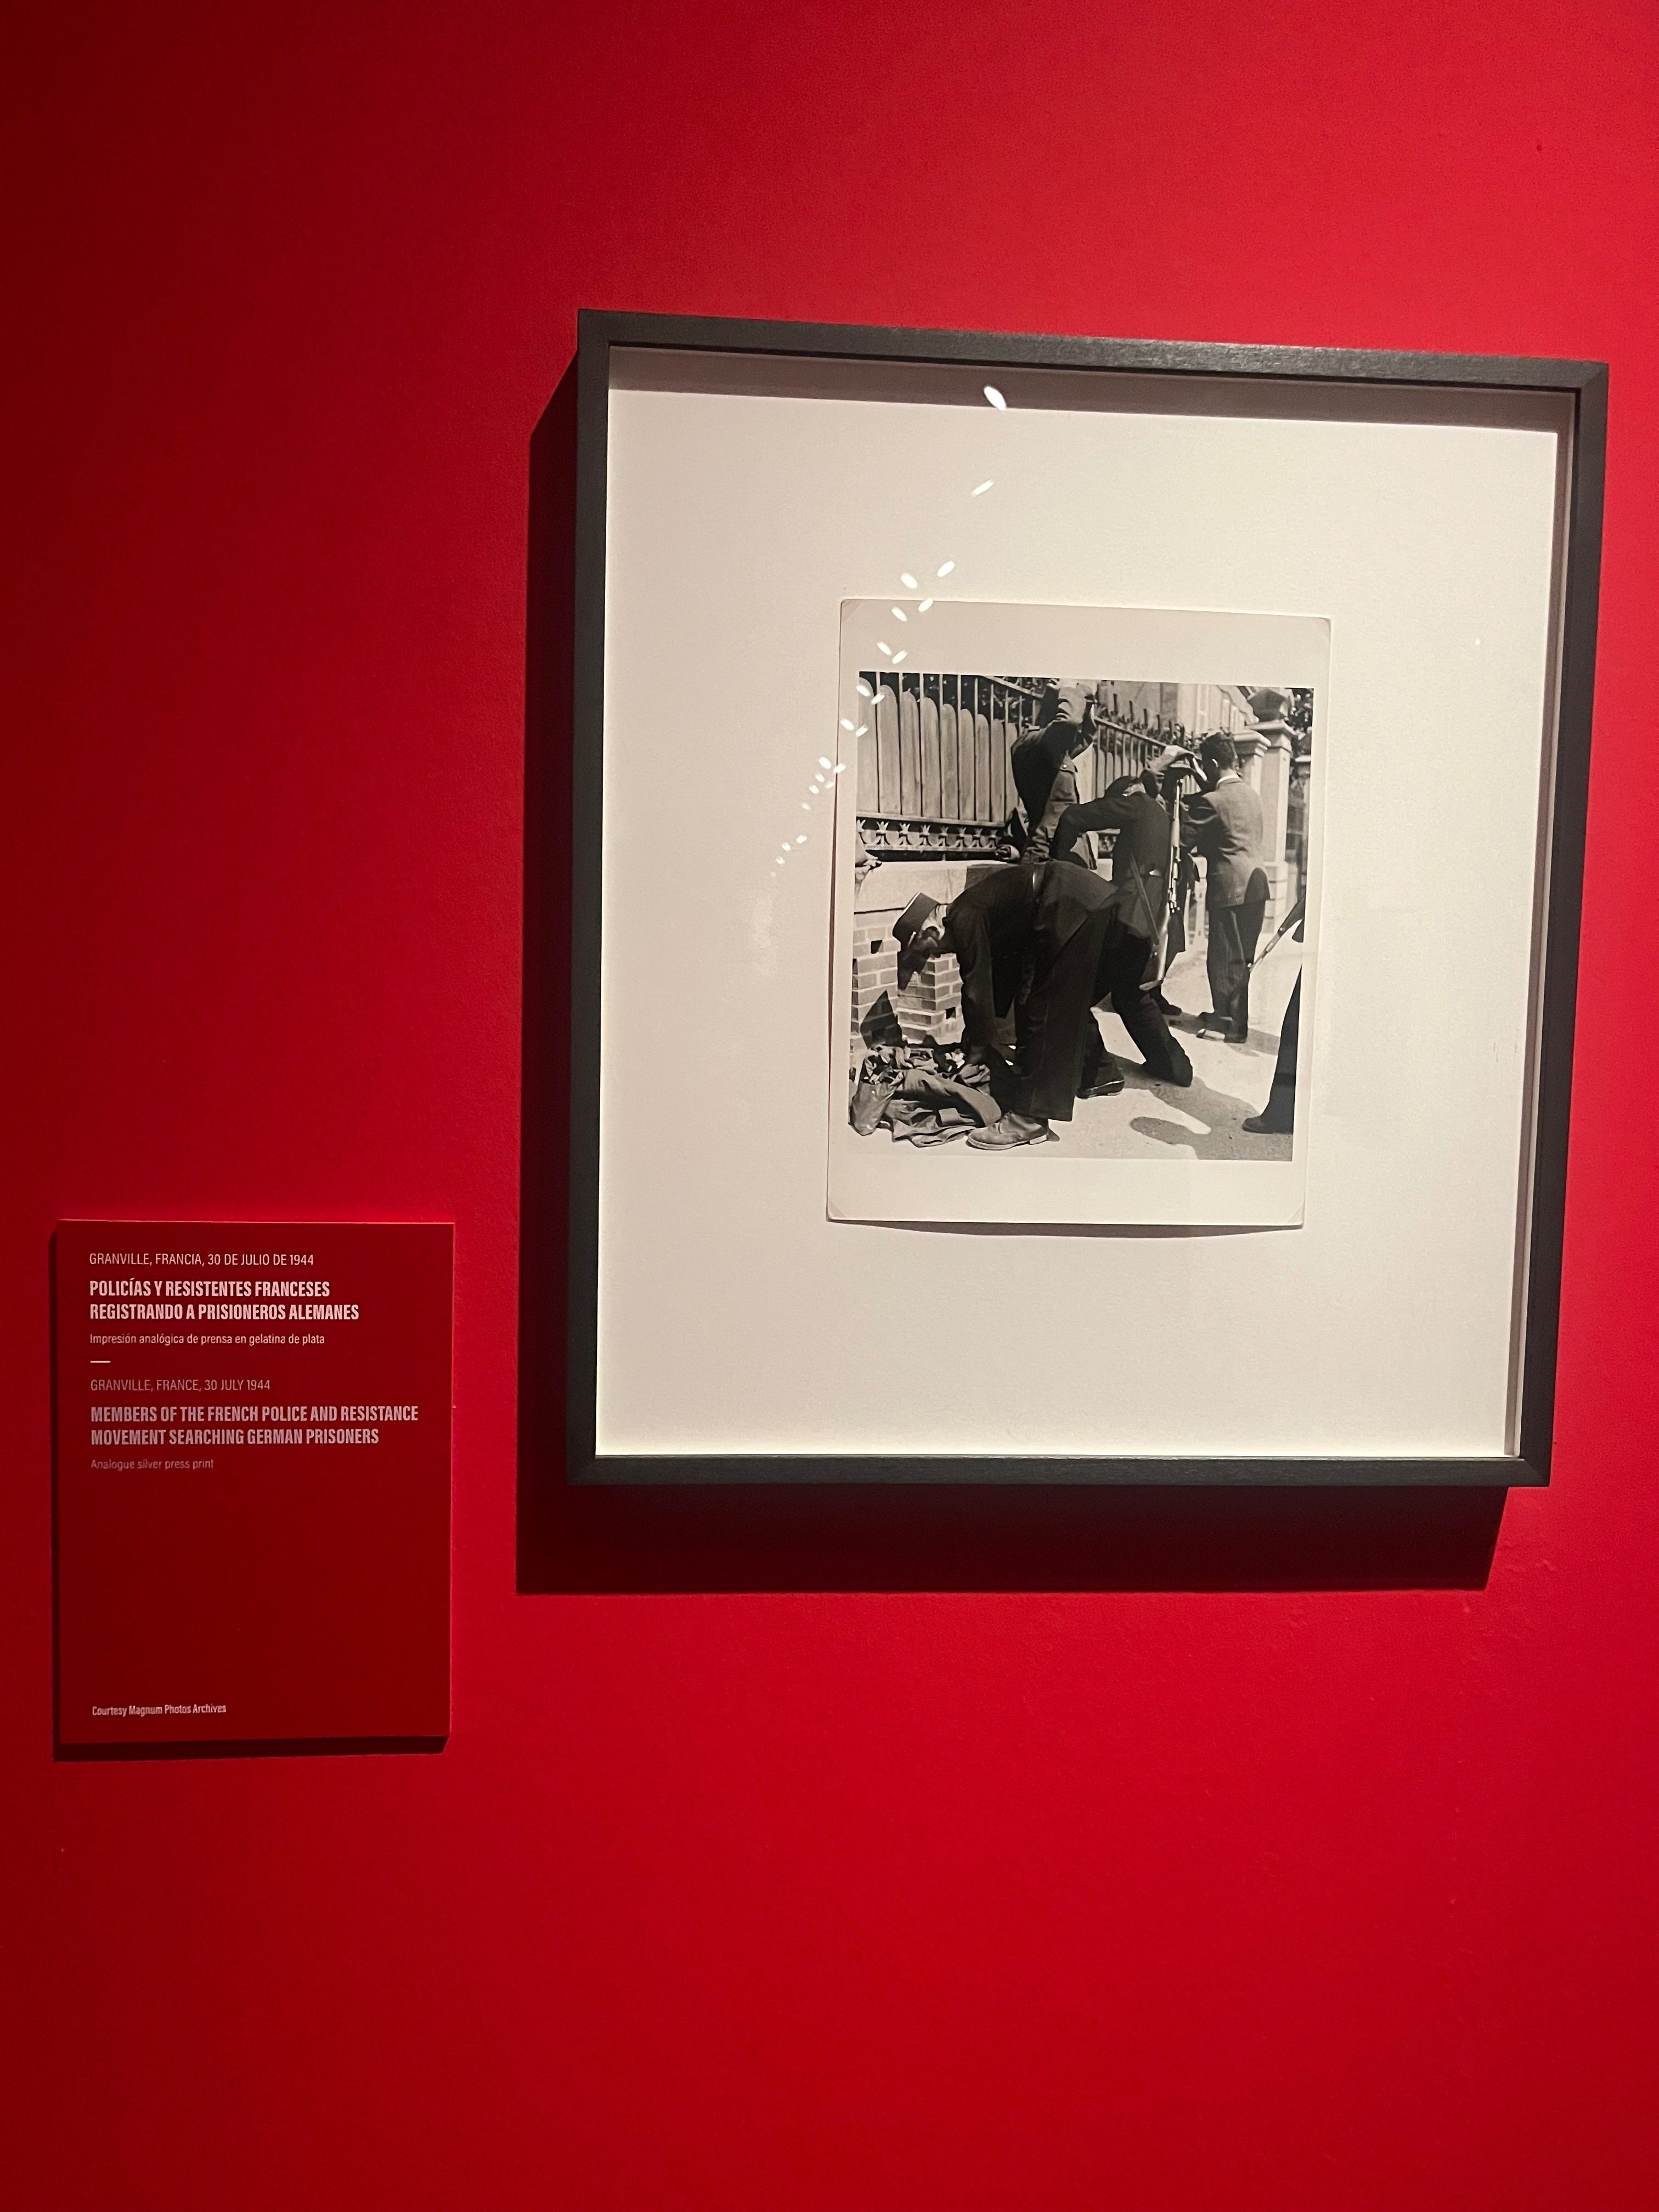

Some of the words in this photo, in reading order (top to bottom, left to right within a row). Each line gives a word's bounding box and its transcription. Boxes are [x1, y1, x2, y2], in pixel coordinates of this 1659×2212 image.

[90, 1253, 152, 1266] GRANVILLE,
[156, 1254, 205, 1266] FRANCIA,
[208, 1254, 221, 1265] 30
[224, 1254, 238, 1265] DE
[241, 1254, 269, 1265] JULIO
[273, 1254, 287, 1265] DE
[290, 1255, 313, 1265] 1944
[90, 1278, 151, 1296] POLICÍAS
[154, 1281, 162, 1296] Y
[166, 1281, 251, 1296] RESISTENTES
[255, 1282, 330, 1296] FRANCESES
[91, 1304, 183, 1319] REGISTRANDO
[186, 1305, 195, 1319] A
[199, 1304, 285, 1319] PRISIONEROS
[289, 1305, 359, 1319] ALEMANES
[91, 1334, 136, 1345] Impresión
[139, 1334, 184, 1346] analógica
[187, 1334, 198, 1344] de
[201, 1336, 232, 1345] prensa
[249, 1334, 285, 1346] gelatina
[289, 1334, 300, 1344] de
[302, 1334, 324, 1346] plata
[91, 1379, 153, 1392] GRANVILLE,
[157, 1379, 201, 1391] FRANCE,
[205, 1380, 217, 1390] 30
[221, 1379, 244, 1390] JULY
[247, 1380, 270, 1390] 1944
[92, 1407, 157, 1421] MEMBERS
[161, 1407, 177, 1421] OF
[180, 1407, 204, 1421] THE
[208, 1406, 258, 1421] FRENCH
[262, 1406, 307, 1421] POLICE
[311, 1406, 337, 1421] AND
[341, 1406, 418, 1421] RESISTANCE
[92, 1430, 166, 1444] MOVEMENT
[170, 1429, 244, 1444] SEARCHING
[247, 1429, 302, 1444] GERMAN
[307, 1429, 379, 1443] PRISONERS
[91, 1459, 134, 1471] Analogue
[138, 1459, 162, 1469] silver
[165, 1461, 190, 1470] press
[193, 1459, 213, 1470] print
[92, 1706, 127, 1717] Courtesy
[129, 1705, 162, 1717] Magnum
[165, 1705, 191, 1714] Photos
[193, 1703, 226, 1713] Archives
